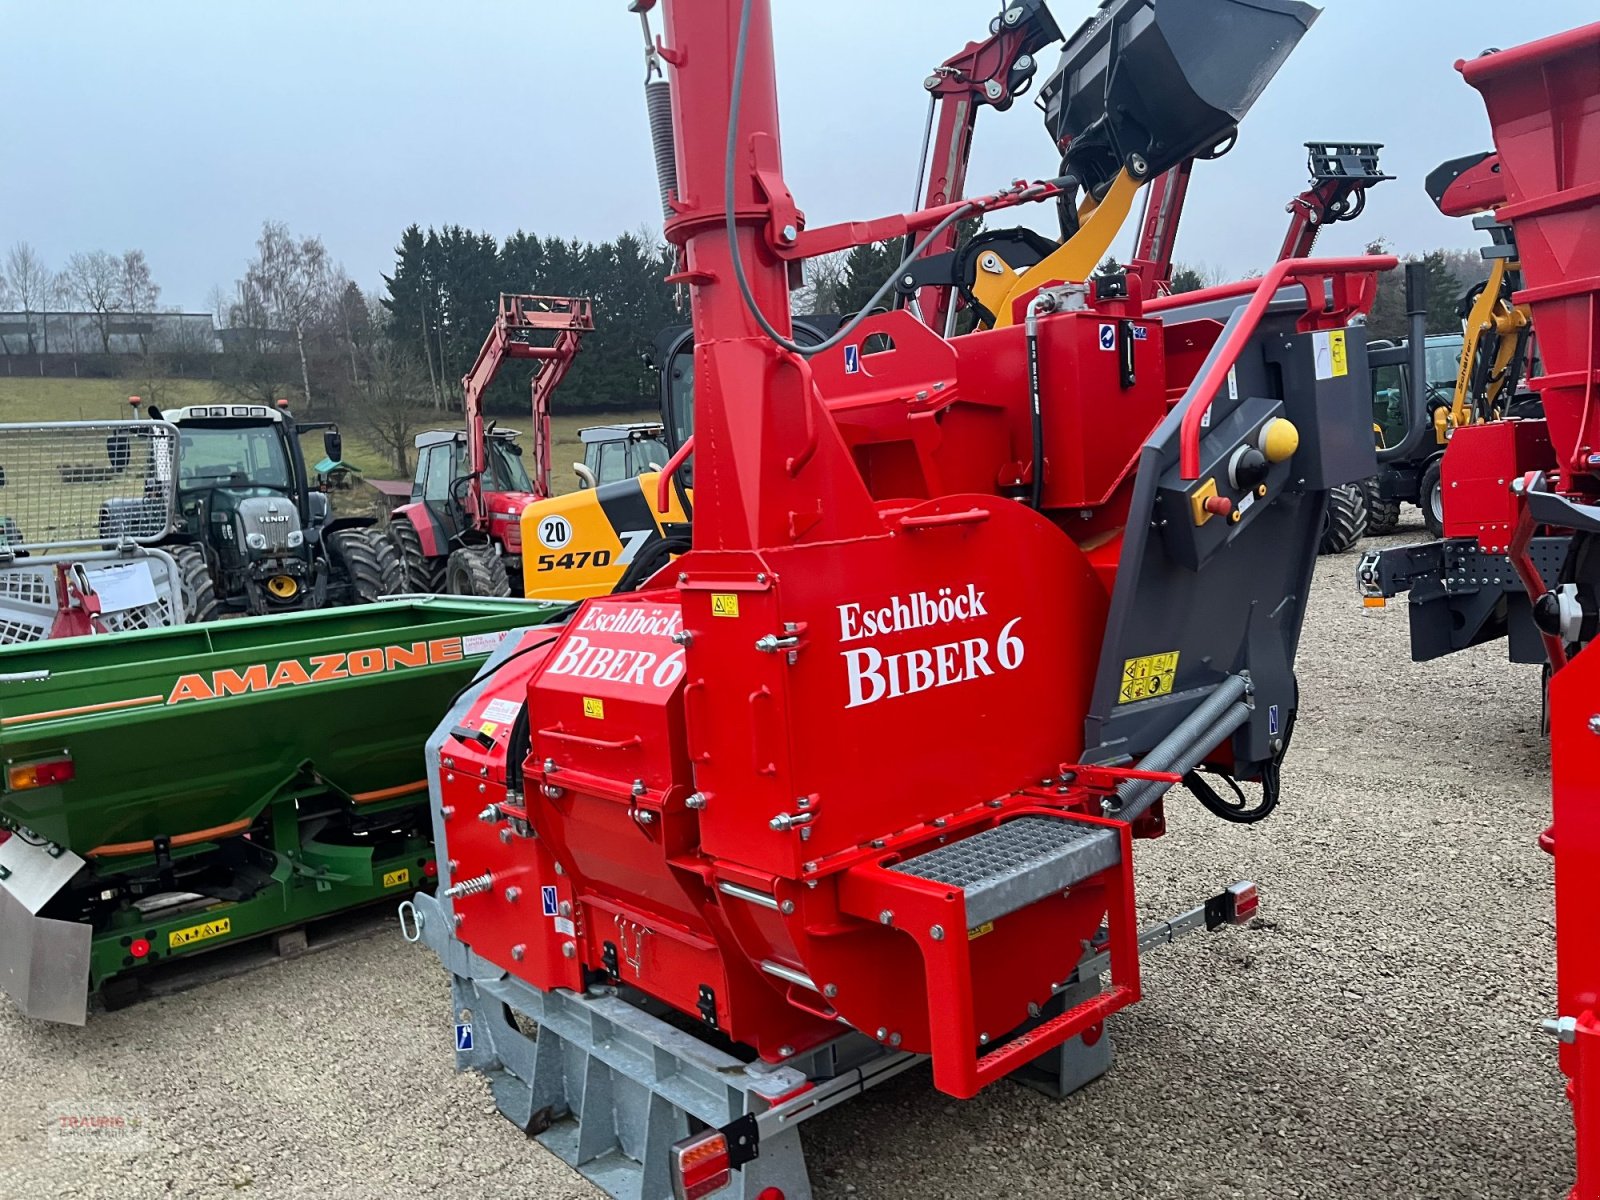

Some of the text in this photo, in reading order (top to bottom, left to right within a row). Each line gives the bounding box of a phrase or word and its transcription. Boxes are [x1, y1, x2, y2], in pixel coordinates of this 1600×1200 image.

[259, 515, 290, 523] FENDT
[545, 522, 565, 543] 20
[537, 550, 610, 572] 5470
[576, 606, 682, 637] Eschlböck
[836, 584, 988, 642] Eschlböck
[167, 637, 463, 705] AMAZONE
[546, 635, 686, 687] BIBER 6
[840, 617, 1025, 709] BIBER 6
